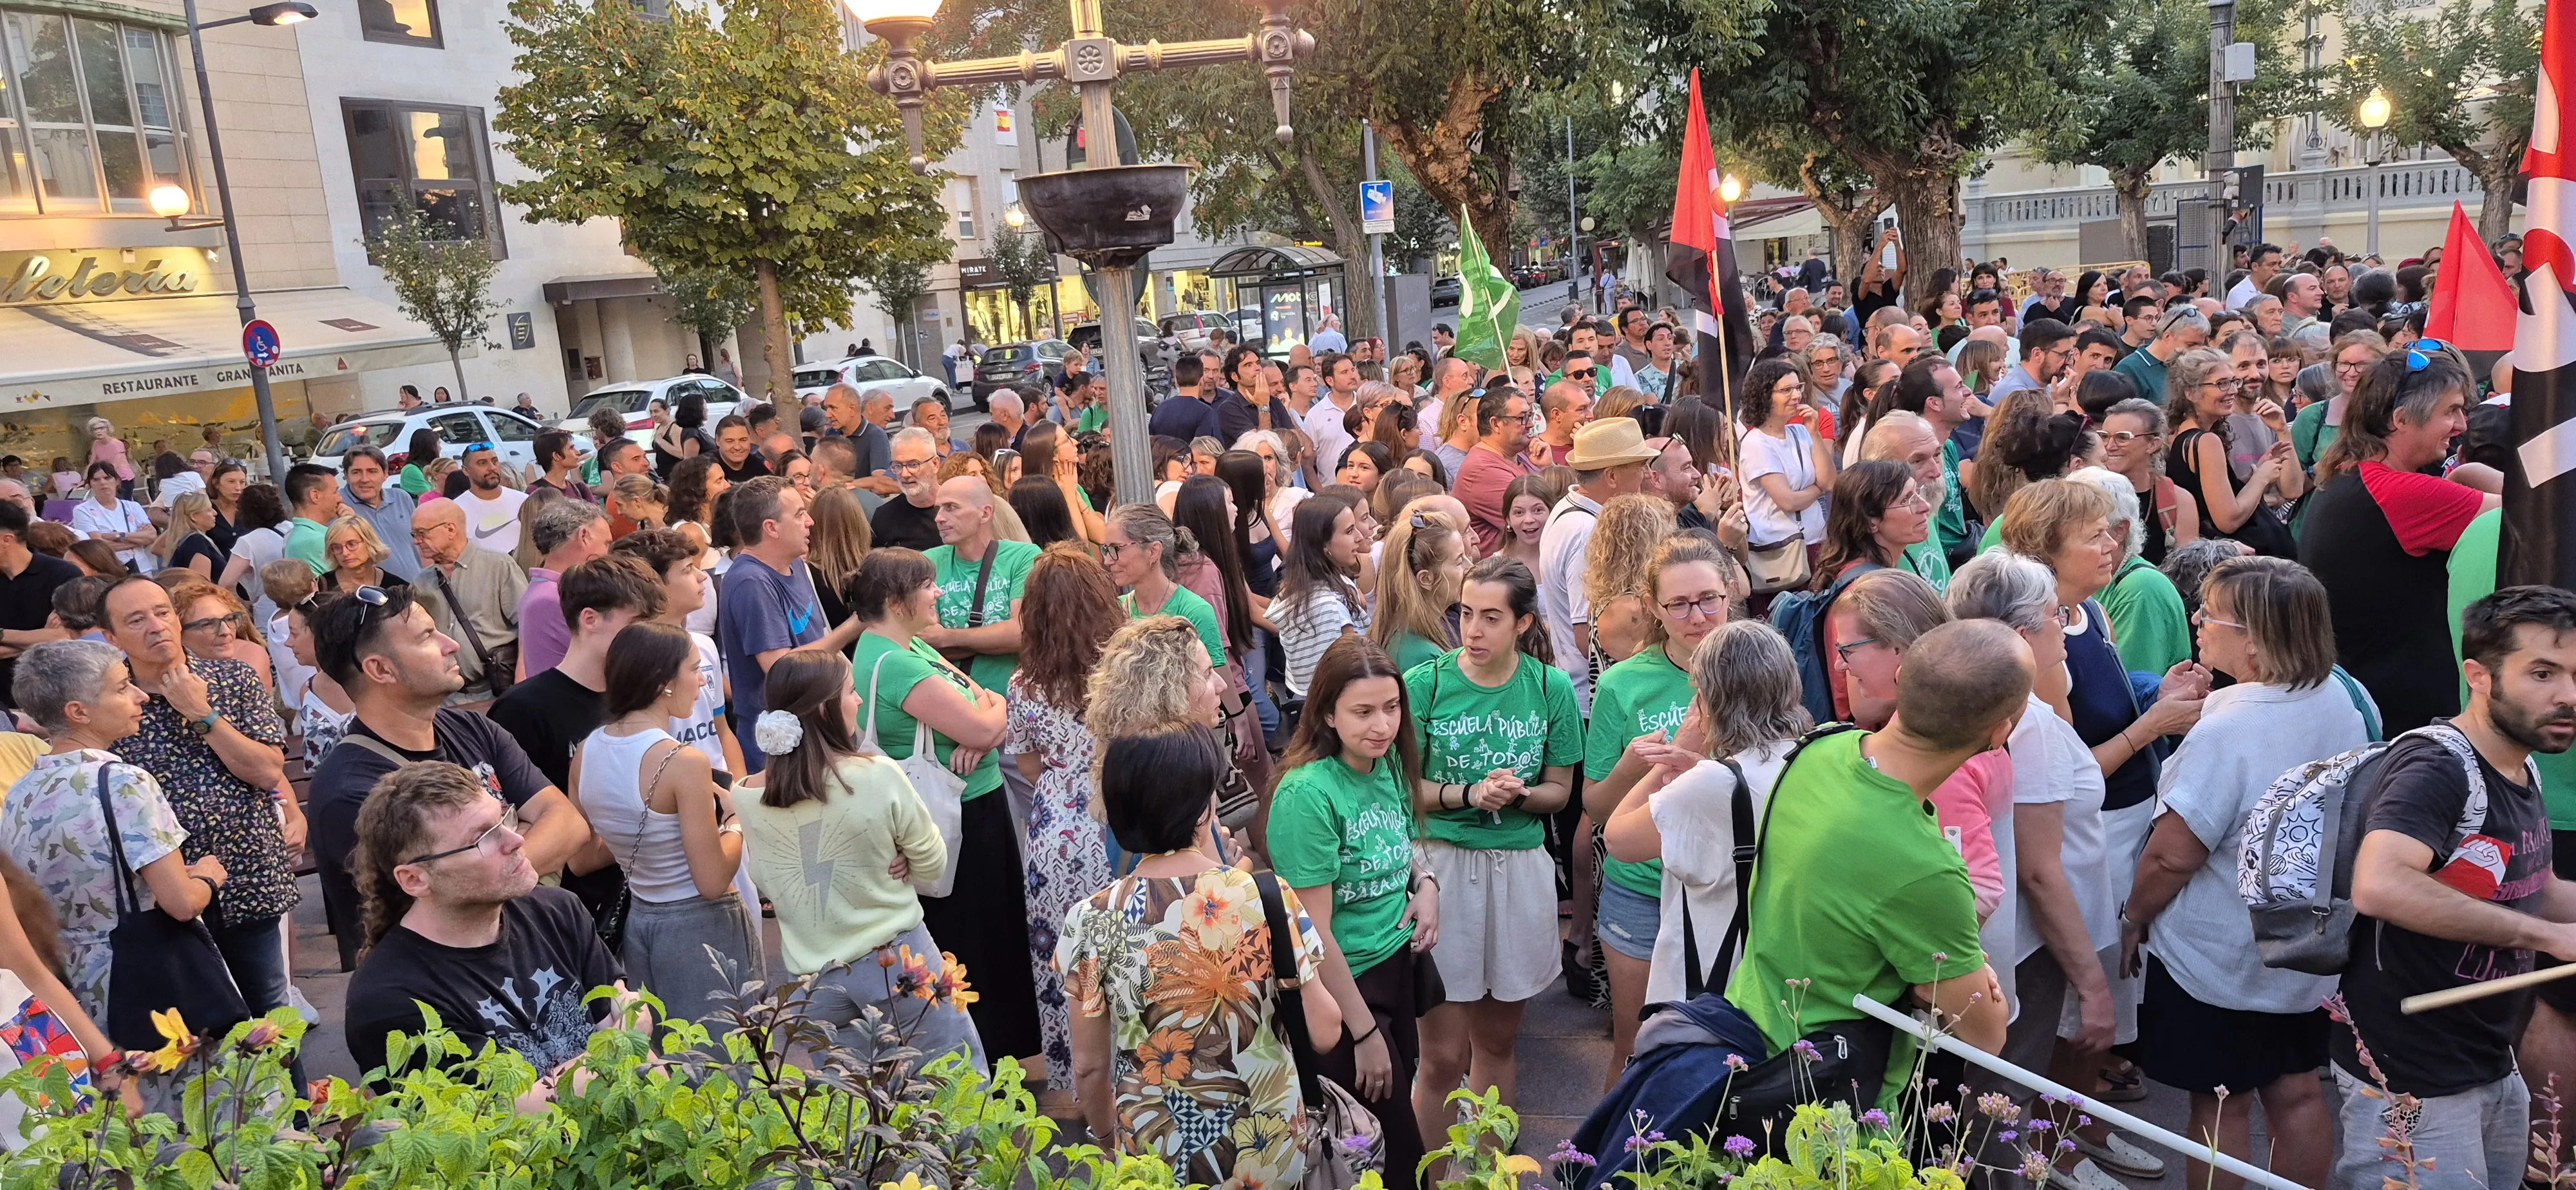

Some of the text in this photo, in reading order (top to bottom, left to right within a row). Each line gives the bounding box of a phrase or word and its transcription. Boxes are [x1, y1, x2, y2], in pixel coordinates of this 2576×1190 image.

[960, 265, 987, 274] MIRATE
[102, 374, 199, 395] RESTAURANTE
[940, 580, 971, 594] SCUELA
[942, 605, 959, 617] DE
[1433, 714, 1493, 736] ESCUELA
[1446, 750, 1540, 769] DE TOD@S
[1360, 855, 1381, 874] DE
